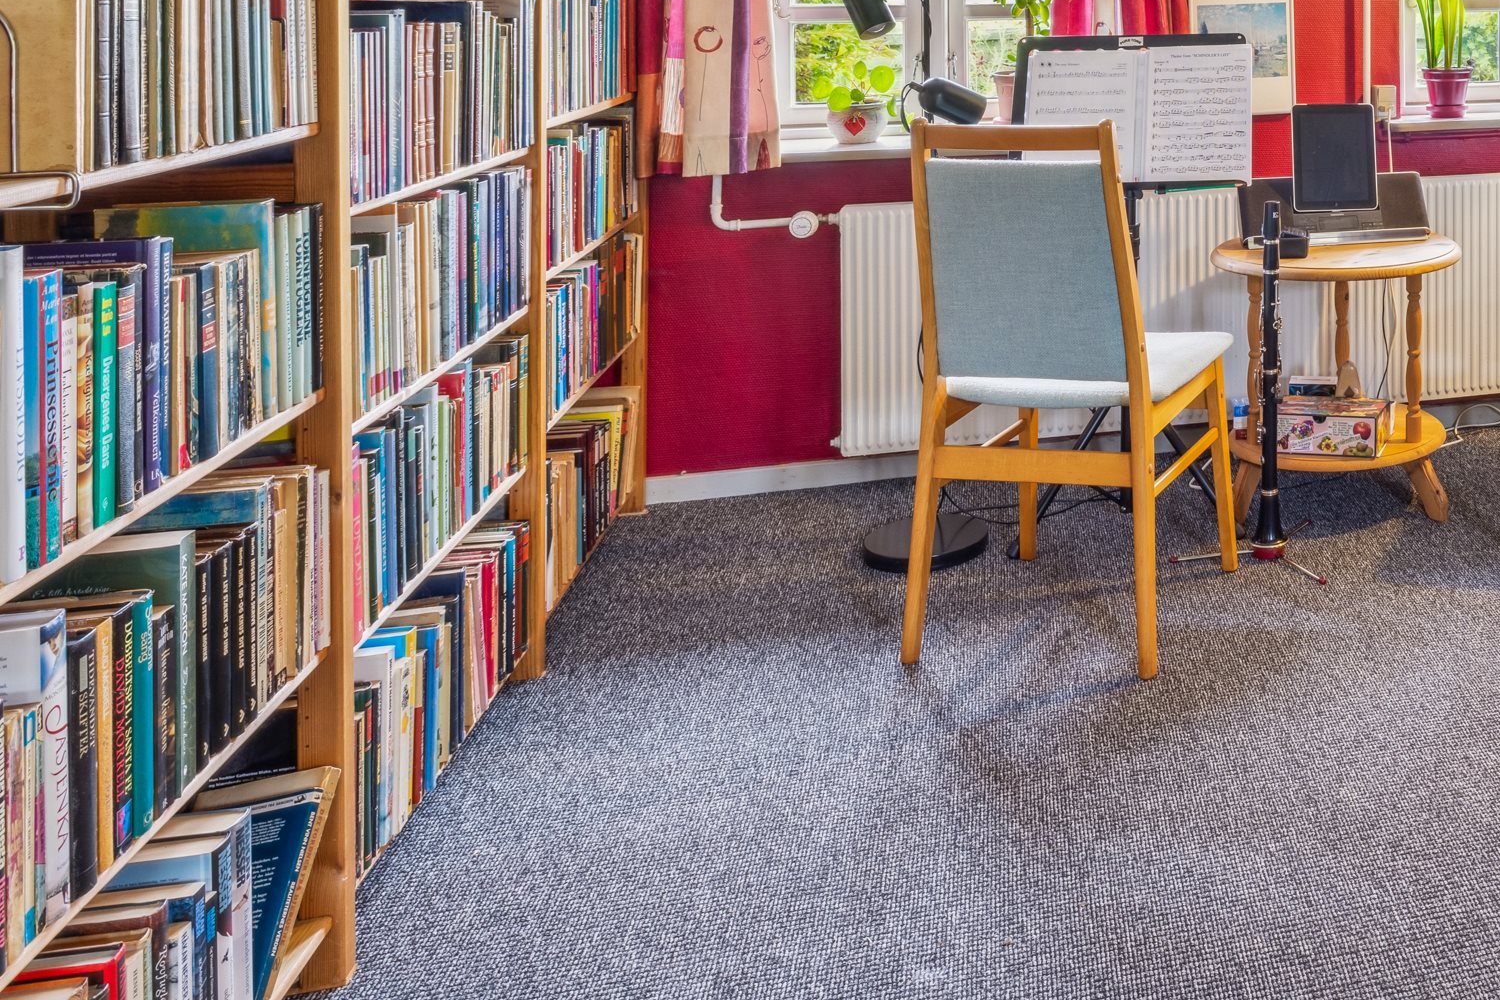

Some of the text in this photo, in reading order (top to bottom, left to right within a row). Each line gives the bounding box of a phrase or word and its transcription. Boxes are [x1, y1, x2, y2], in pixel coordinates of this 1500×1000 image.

[100, 356, 113, 469] Dværgenes Dans
[151, 390, 160, 461] Velkommen
[145, 606, 153, 671] Salomons
[180, 555, 188, 655] KATE MORTON
[124, 621, 133, 719] DOBBELTSPIL
[138, 632, 149, 664] sang
[79, 693, 88, 759] SKIFTER
[88, 651, 96, 748] TIDEVANDET
[115, 659, 126, 803] DAVID MORRELL
[125, 728, 133, 771] SANTA
[125, 773, 133, 795] FE
[218, 849, 228, 914] NESSER
[236, 827, 246, 888] NESSER
[270, 811, 316, 957] BENT VINN NIELSEN REALITETERNES VERDEN
